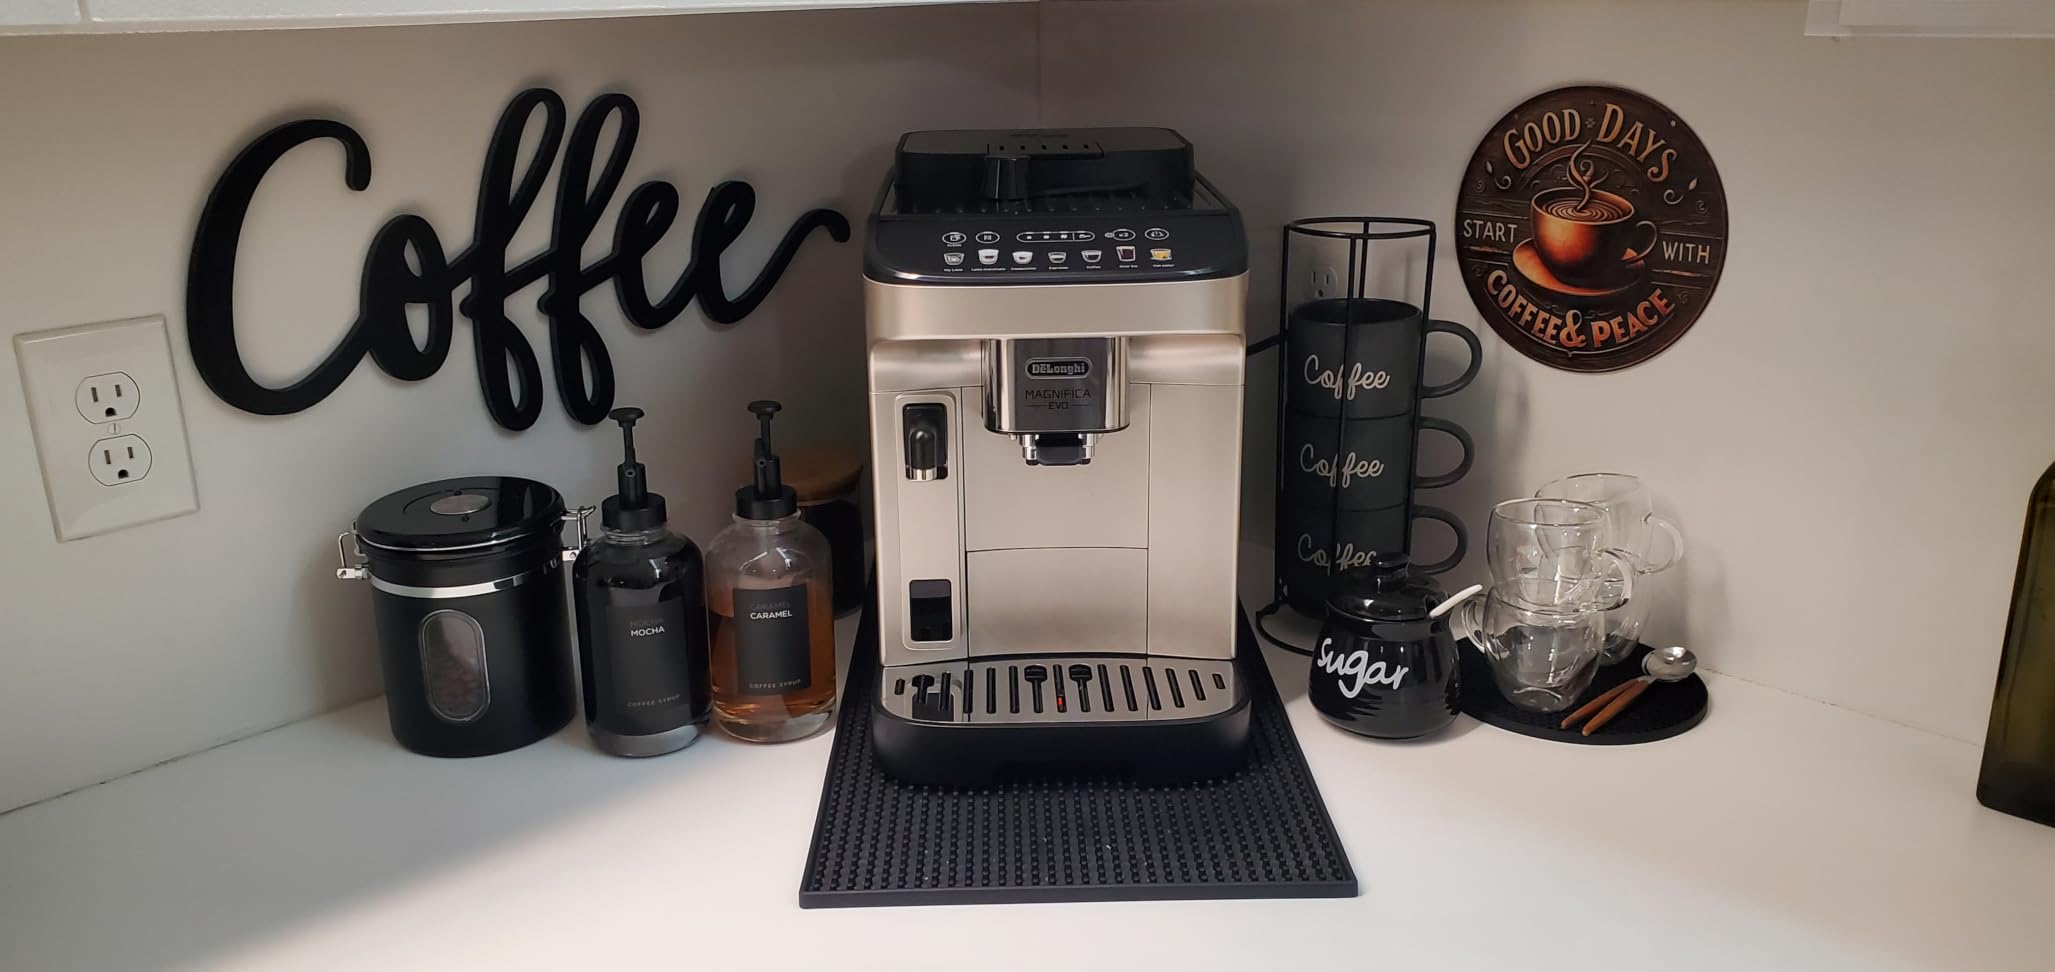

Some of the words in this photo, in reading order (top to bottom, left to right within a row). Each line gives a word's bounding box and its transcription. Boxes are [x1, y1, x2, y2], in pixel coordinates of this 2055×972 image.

[1504, 108, 1581, 169] GOOD
[1597, 103, 1677, 182] DAYS
[186, 87, 851, 432] Coffee
[1463, 219, 1518, 244] START
[1662, 241, 1711, 264] WITH
[1487, 269, 1562, 344] COFFEE
[1591, 288, 1675, 348] PEACE
[1025, 389, 1092, 400] MAGNIFICA
[1304, 354, 1391, 400] Coffee
[1048, 401, 1070, 410] EVO
[1300, 443, 1385, 488] Coffee
[630, 626, 665, 637] MOCHA
[750, 610, 793, 620] CARAMEL
[627, 700, 656, 708] COFFEE
